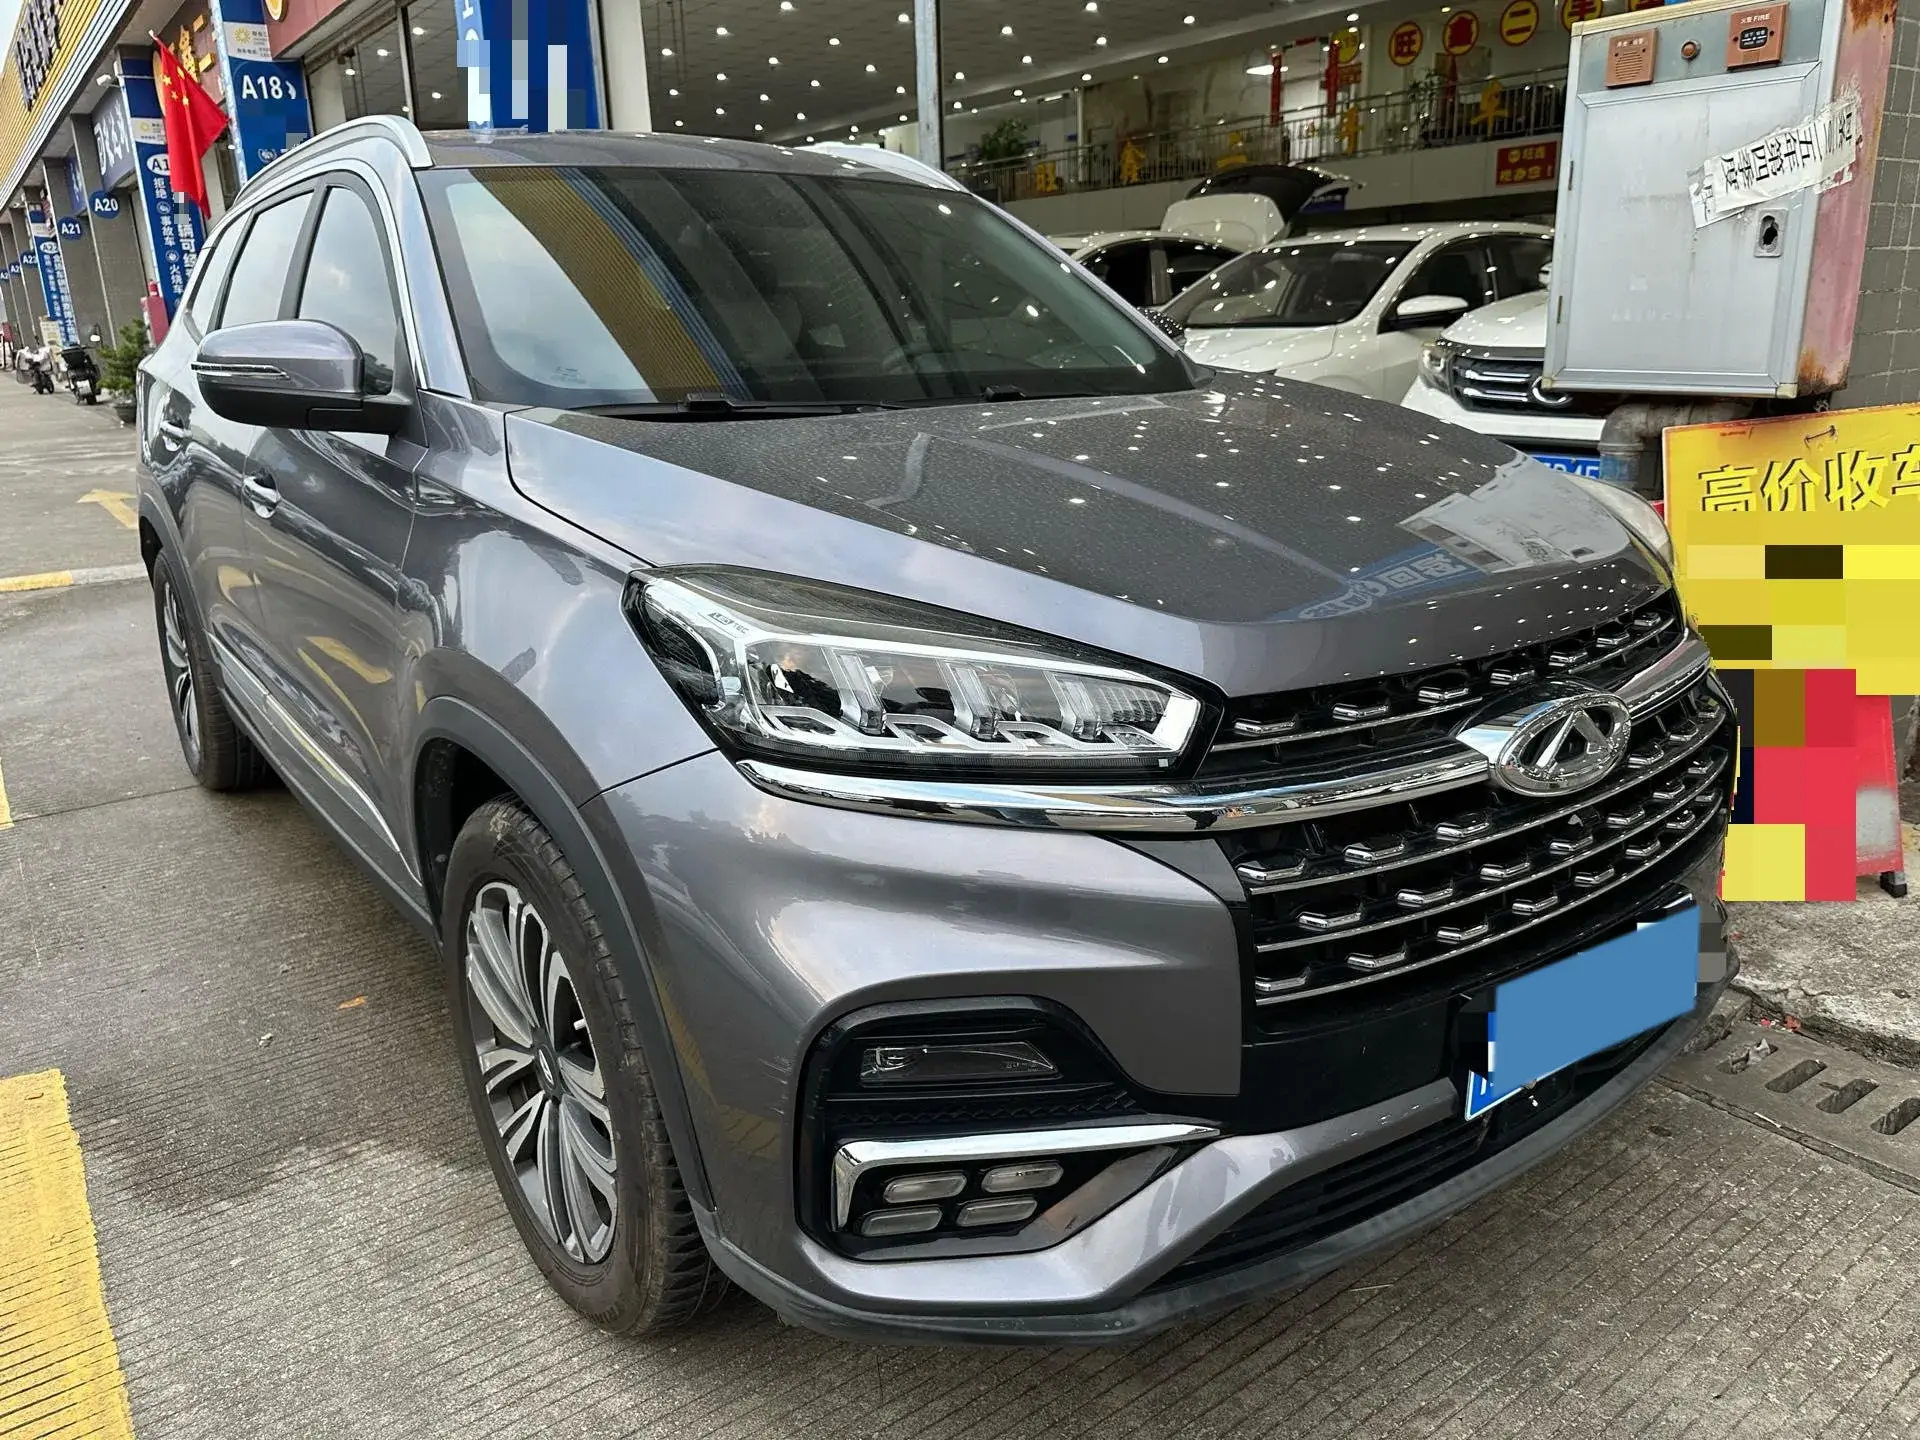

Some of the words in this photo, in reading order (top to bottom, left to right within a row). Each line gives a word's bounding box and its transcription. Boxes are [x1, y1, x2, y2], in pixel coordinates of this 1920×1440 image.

[1753, 13, 1771, 22] FIRE
[242, 75, 284, 100] A18
[152, 158, 170, 172] A1
[154, 178, 167, 199] 拒绝
[94, 198, 118, 212] A20
[61, 222, 81, 234] A21
[160, 215, 175, 246] 事故车
[170, 264, 183, 294] 火烧车
